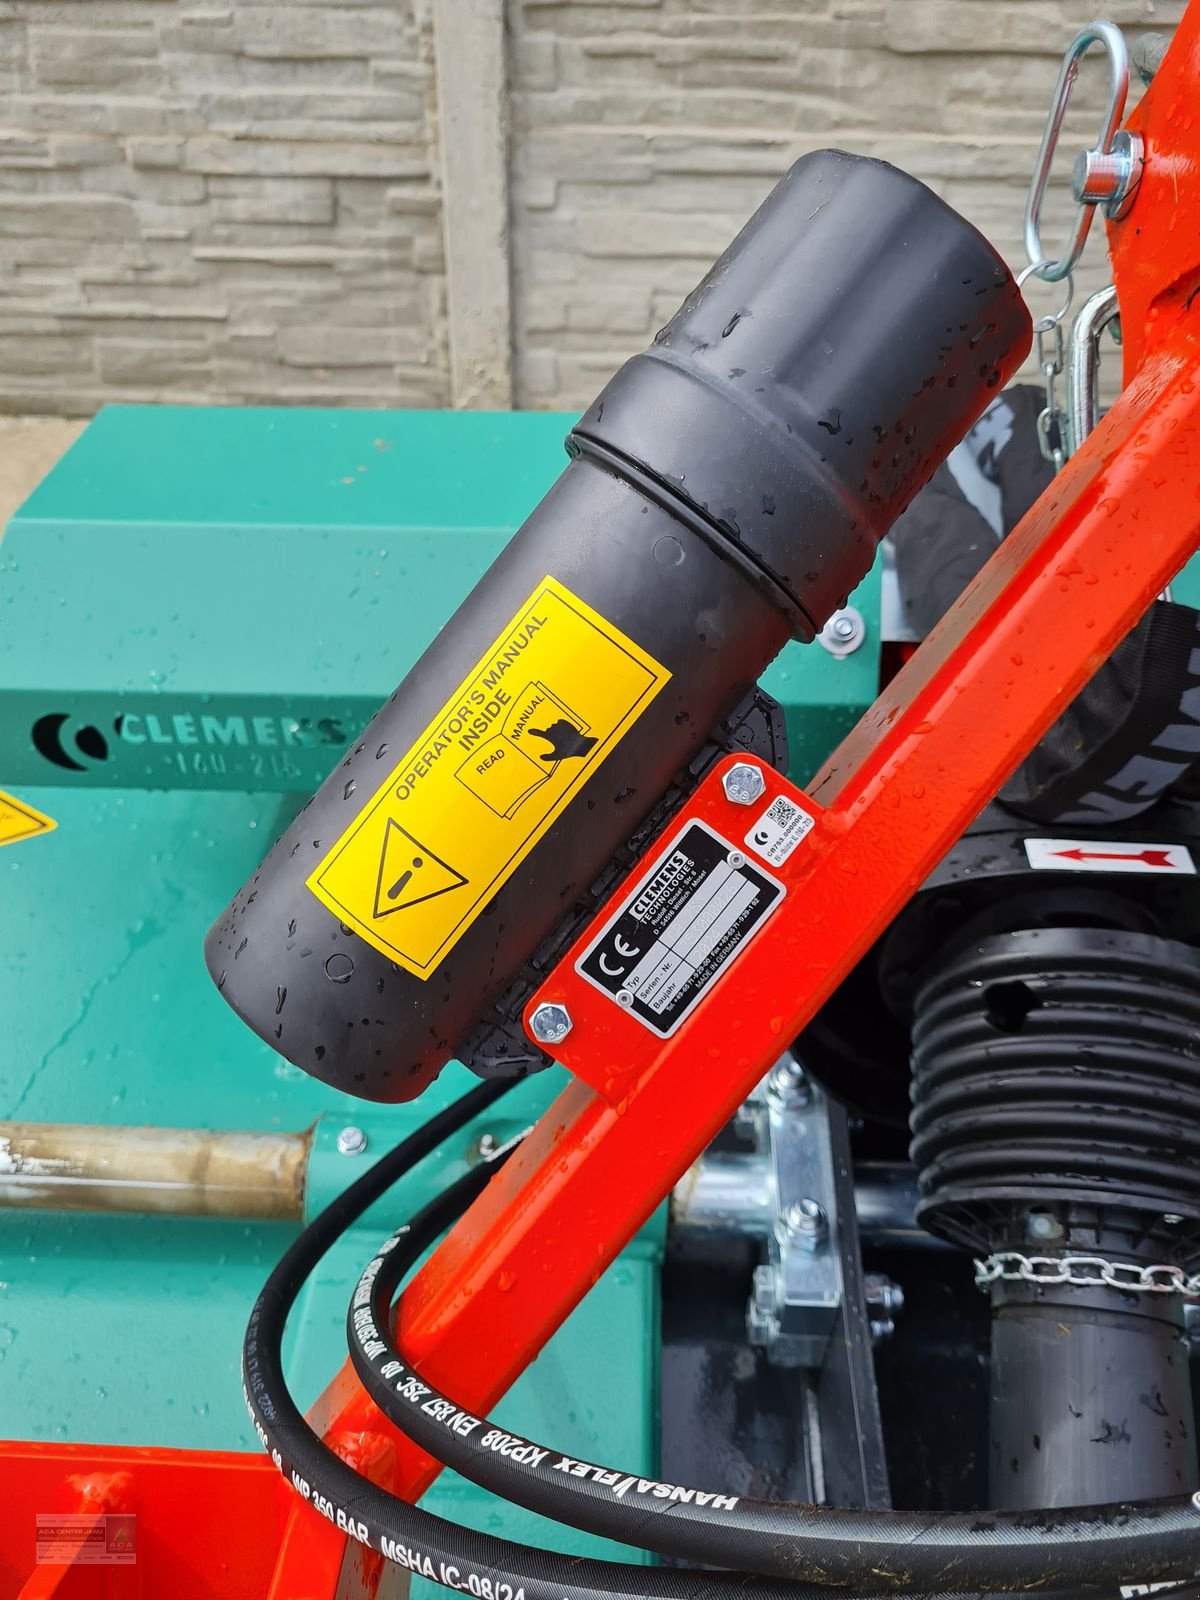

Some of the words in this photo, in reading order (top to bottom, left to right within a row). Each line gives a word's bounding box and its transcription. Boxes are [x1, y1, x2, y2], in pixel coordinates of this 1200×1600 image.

[395, 689, 485, 800] OPERATOR'S
[482, 614, 548, 691] MANUAL
[458, 688, 512, 752] INSIDE
[510, 694, 545, 741] MANUAL
[114, 712, 347, 746] CLEMENS
[475, 748, 506, 776] READ
[632, 854, 685, 916] CLEMENS
[640, 859, 695, 926] TECHNOLOGIES
[650, 907, 668, 926] Rudolf
[667, 887, 684, 906] Diesel
[694, 969, 713, 989] MADE
[709, 961, 719, 971] IN
[715, 931, 743, 964] GERMANY
[626, 974, 642, 990] Typ
[639, 975, 661, 999] Serien
[652, 981, 678, 1011] Baujahr
[420, 1398, 451, 1421] 857
[446, 1413, 482, 1437] EN
[480, 1429, 550, 1468] KP208
[336, 1509, 373, 1548] BAR
[380, 1536, 440, 1582] MSHA
